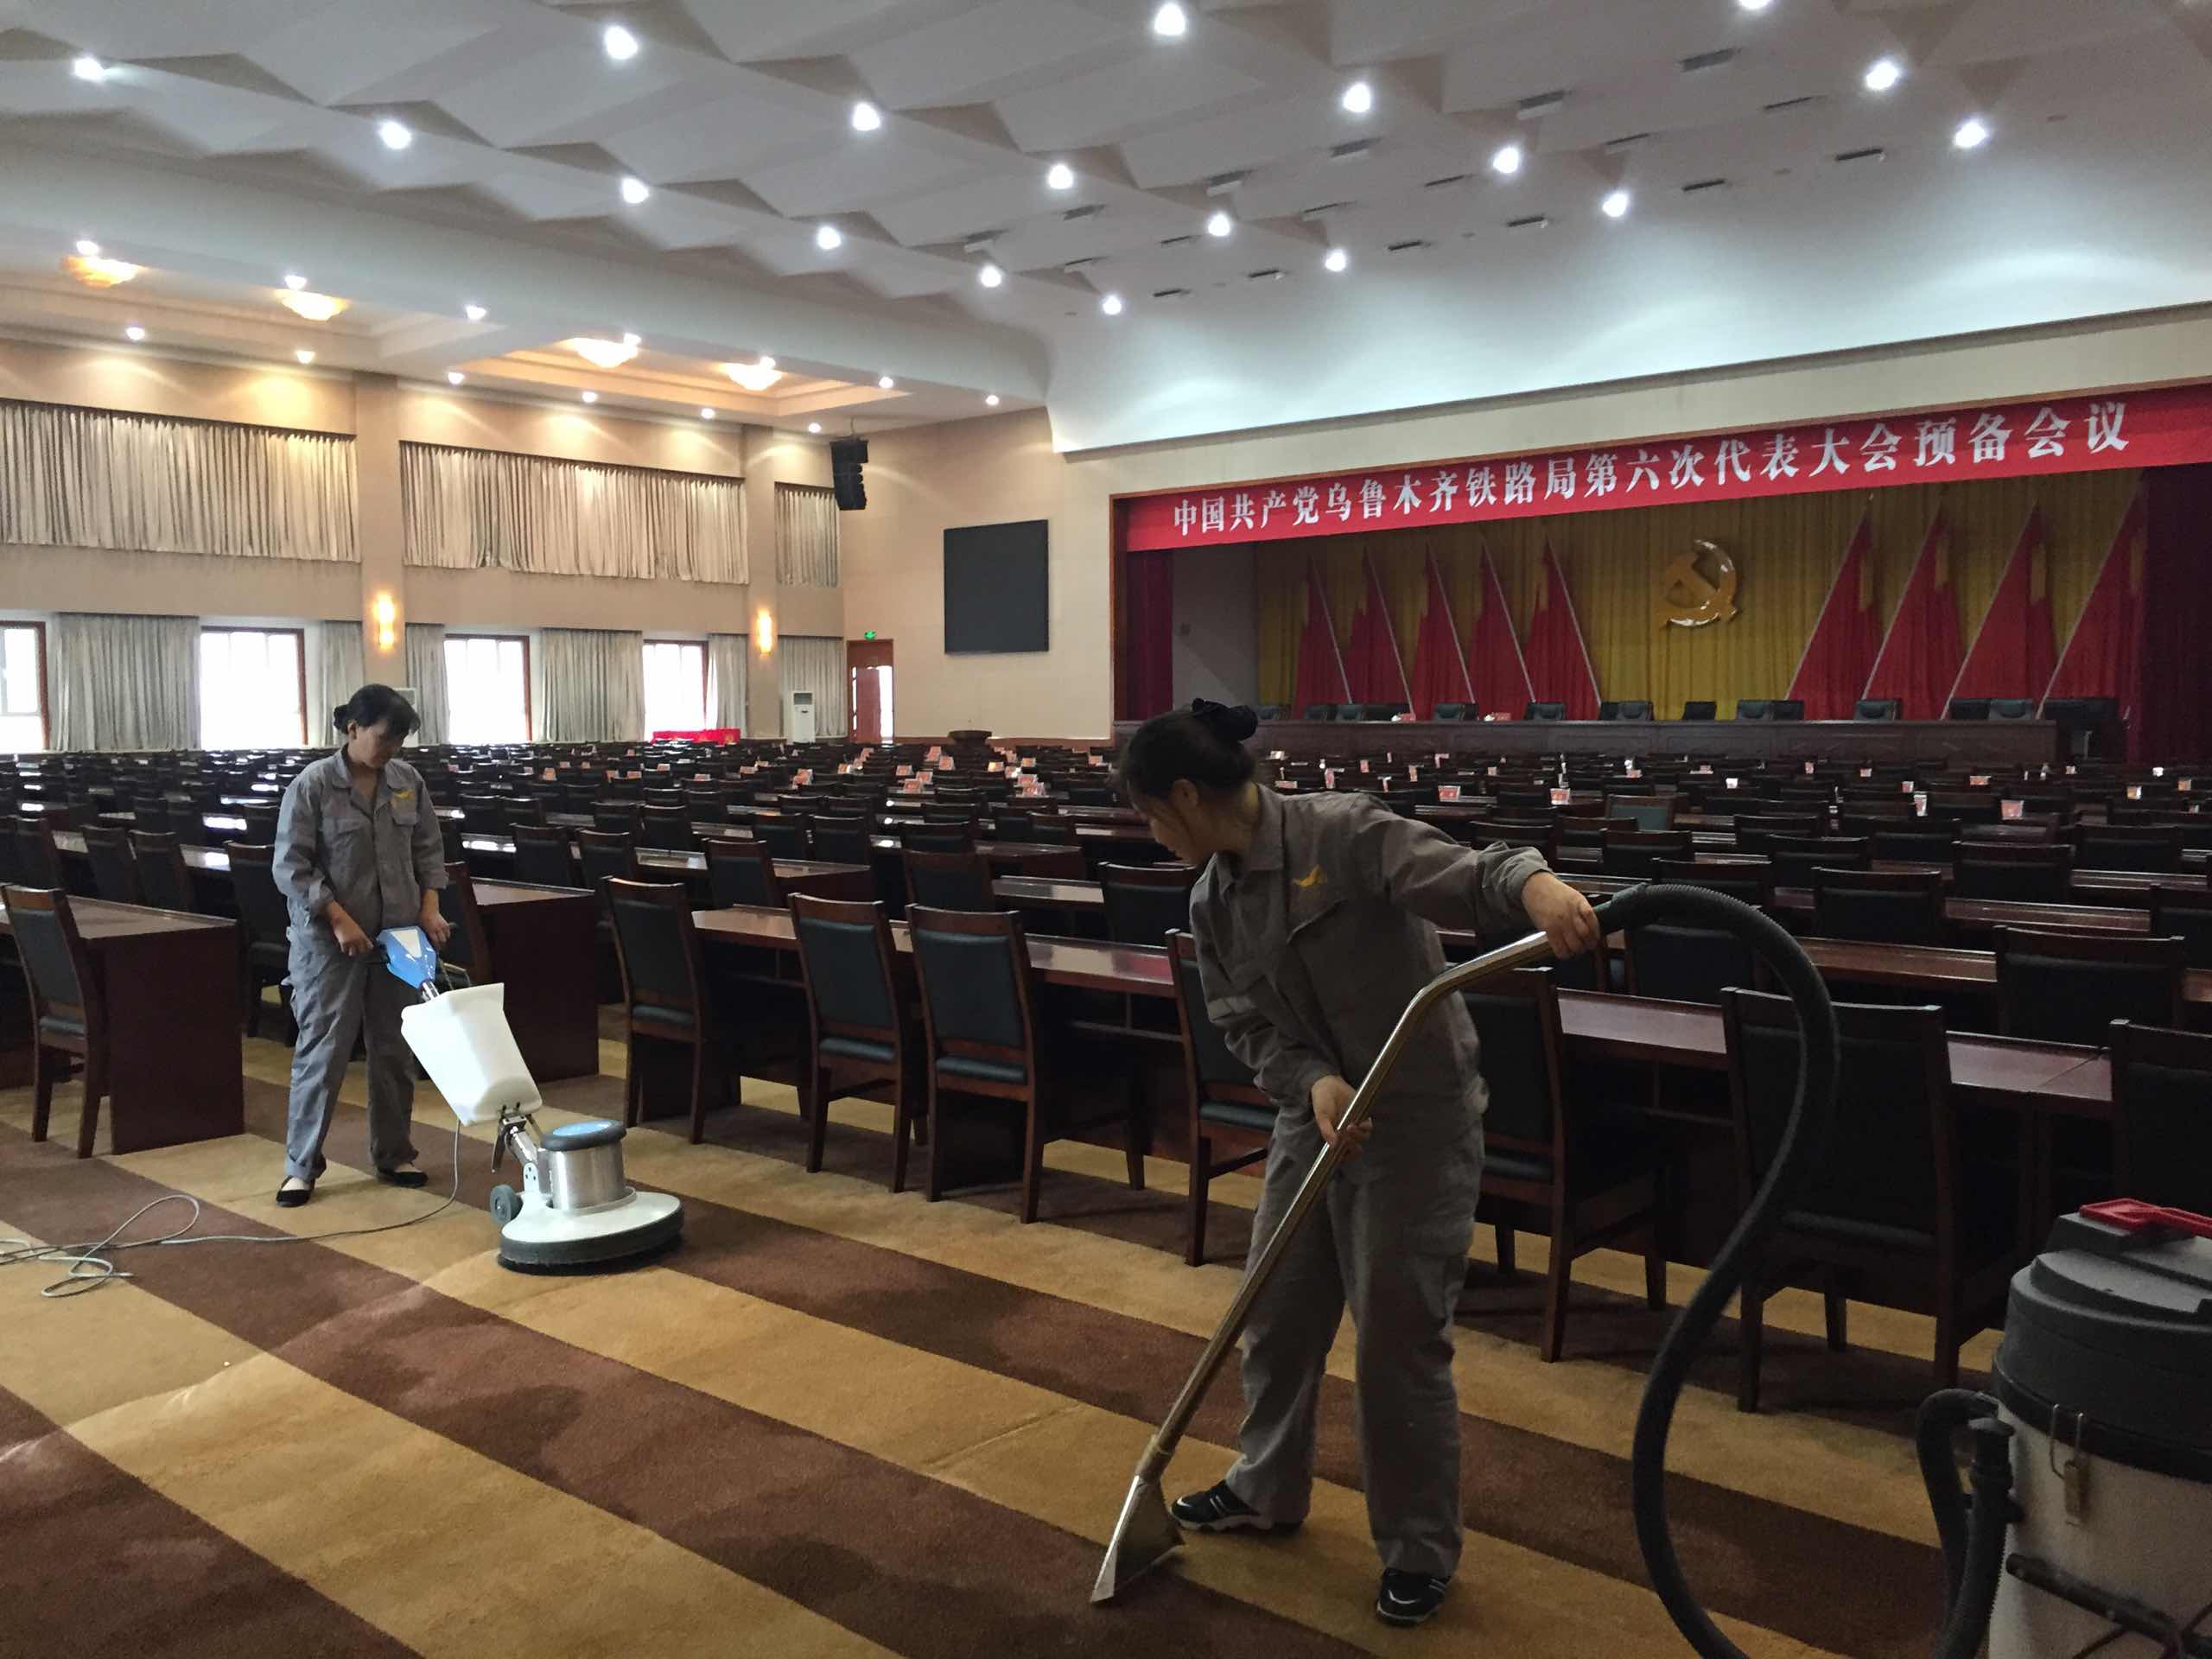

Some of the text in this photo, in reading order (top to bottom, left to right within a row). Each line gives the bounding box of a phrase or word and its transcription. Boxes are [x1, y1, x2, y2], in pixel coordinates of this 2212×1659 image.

[1173, 402, 2130, 537] 中国共产党乌鲁木齐铁路局第六次代表大会预备会议
